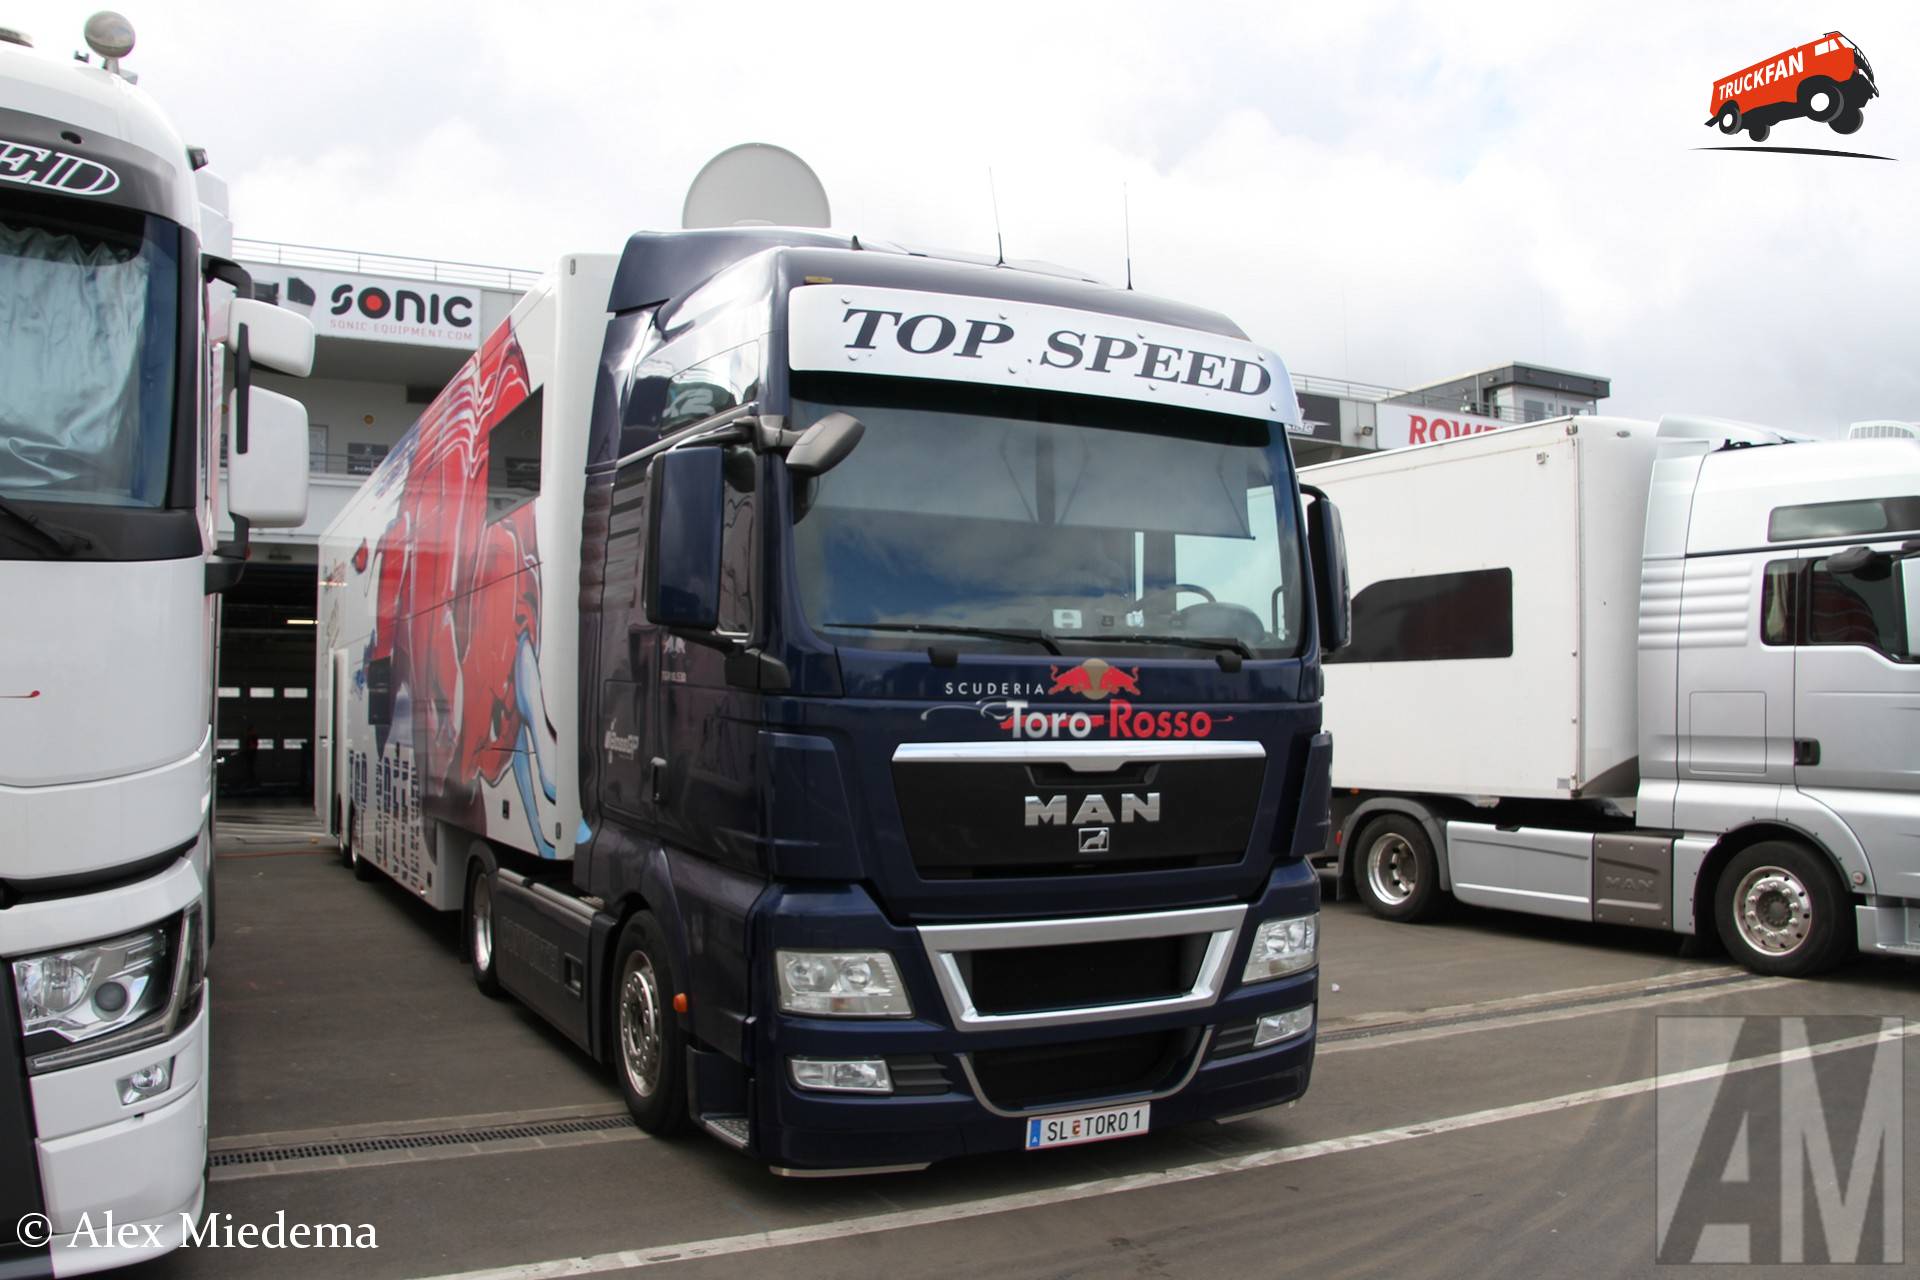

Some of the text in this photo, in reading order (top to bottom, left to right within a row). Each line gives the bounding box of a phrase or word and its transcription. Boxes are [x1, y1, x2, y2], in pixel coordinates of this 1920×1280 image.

[330, 284, 473, 328] SONIC
[842, 308, 1272, 396] TOP SPEED
[1408, 414, 1503, 445] ROW
[945, 682, 1044, 695] SCUDERIA
[1006, 699, 1212, 739] Toro Rosso
[1024, 792, 1160, 826] MAN
[1604, 875, 1655, 891] MAN
[1047, 1121, 1068, 1141] SL
